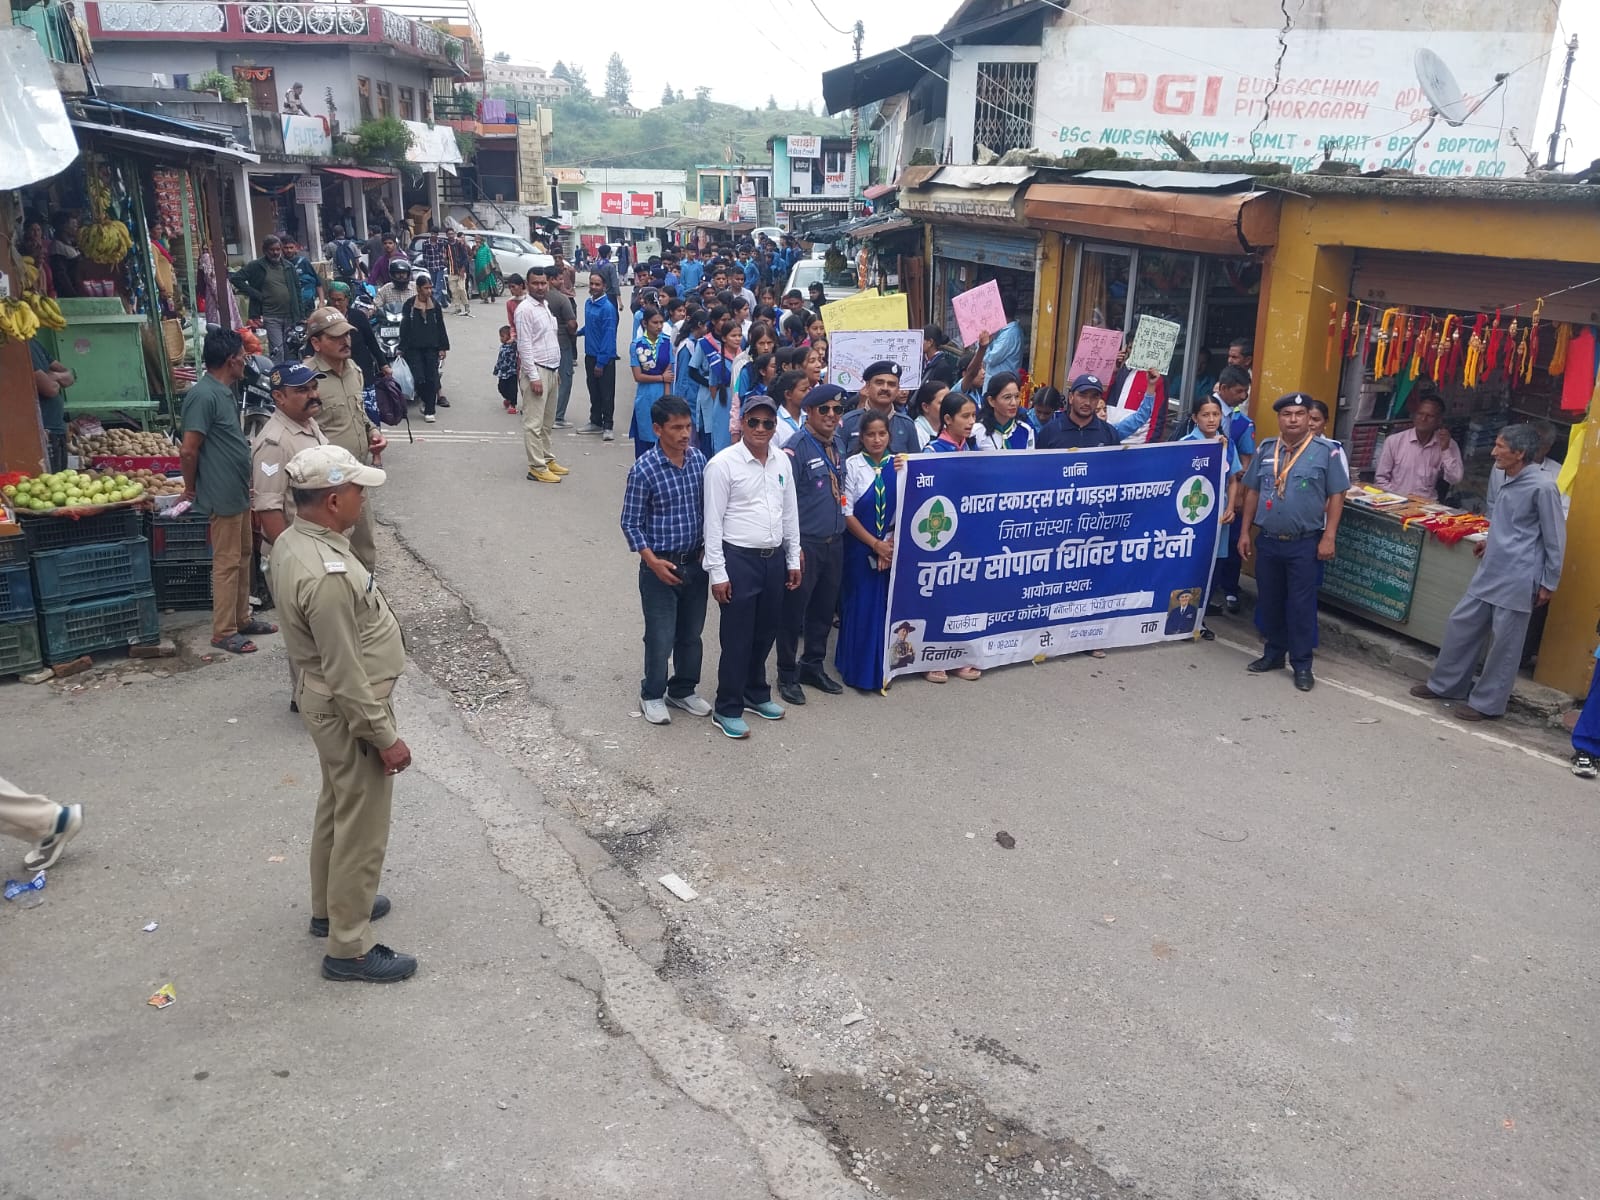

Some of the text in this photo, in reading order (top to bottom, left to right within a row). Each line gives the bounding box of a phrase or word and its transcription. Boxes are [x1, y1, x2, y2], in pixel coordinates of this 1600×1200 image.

[1101, 71, 1224, 116] PGI
[1236, 76, 1380, 99] BUNGACHHINA
[1234, 98, 1370, 120] PITHORAGARH
[1192, 131, 1230, 148] GNM
[1252, 132, 1298, 150] BMLT
[1437, 137, 1499, 153] BOPTOM
[1428, 159, 1465, 176] CHM
[916, 473, 935, 489] सेवा
[1063, 462, 1089, 478] शान्ति
[960, 480, 1176, 515] भारत स्काउट्स एवं गाइड्स उत्तराखण्ड
[998, 519, 1033, 541] जिला
[1077, 511, 1134, 534] पिथौरागढ़
[917, 527, 1196, 598] तृतीय सोपान शिविर एवं रैली
[1021, 580, 1063, 600] आयोजन
[987, 610, 1016, 627] इण्टर
[1140, 620, 1160, 634] तक
